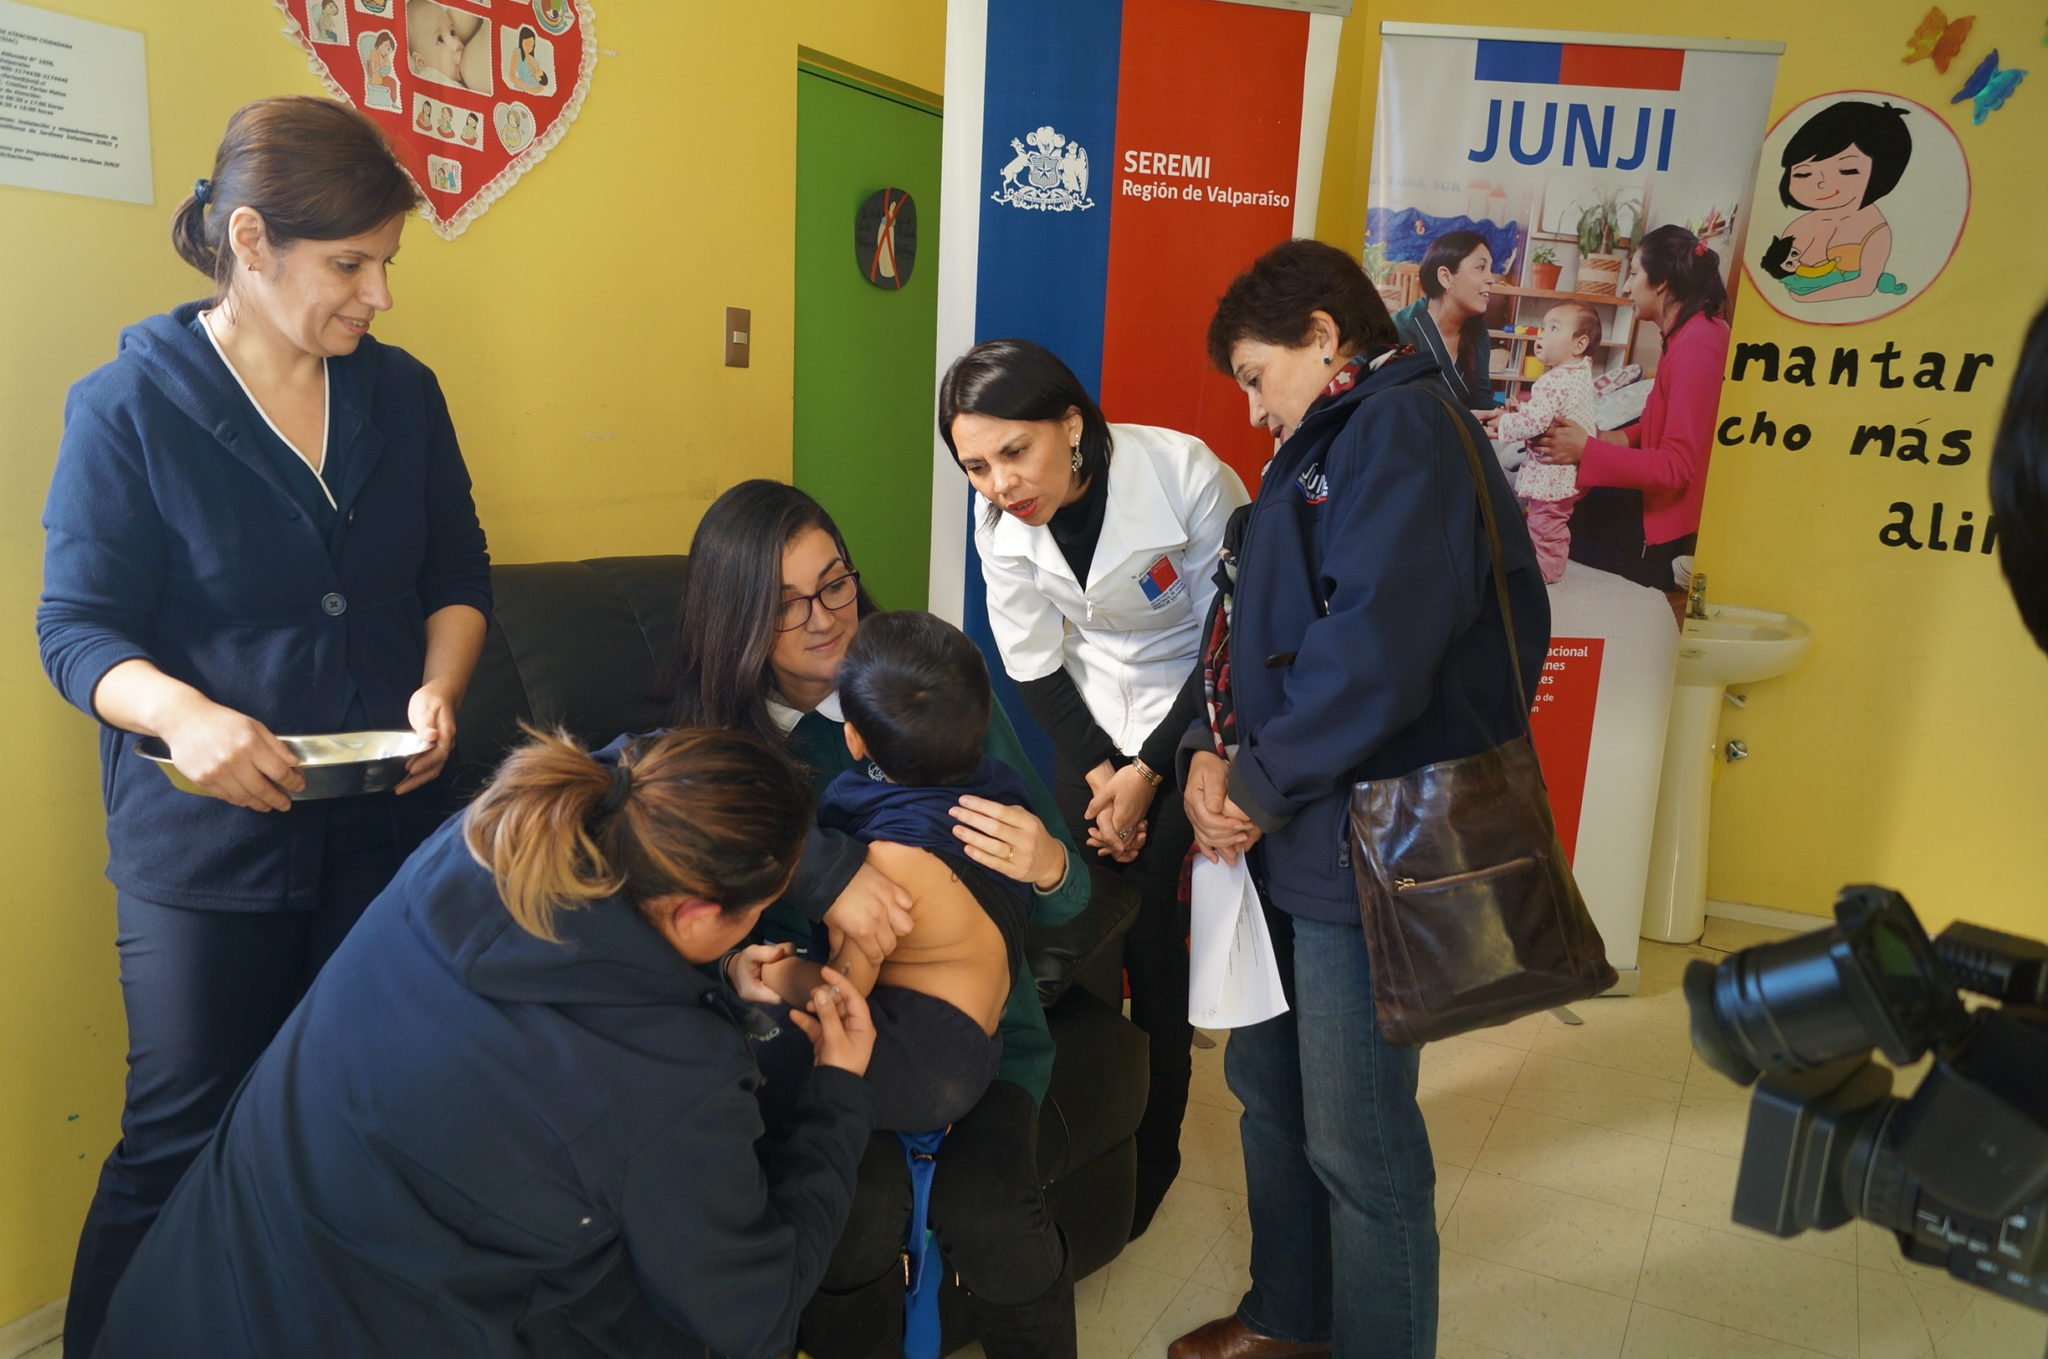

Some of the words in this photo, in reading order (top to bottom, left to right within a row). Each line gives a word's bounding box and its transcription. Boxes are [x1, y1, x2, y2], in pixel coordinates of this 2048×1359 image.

[1467, 99, 1676, 171] JUNJI
[1123, 150, 1210, 179] SEREMI
[1122, 179, 1178, 202] Región
[1182, 184, 1202, 201] de
[1206, 186, 1290, 208] Valparaíso
[1722, 341, 1994, 392] mantar
[1849, 417, 1973, 466] más
[1543, 693, 1554, 702] de
